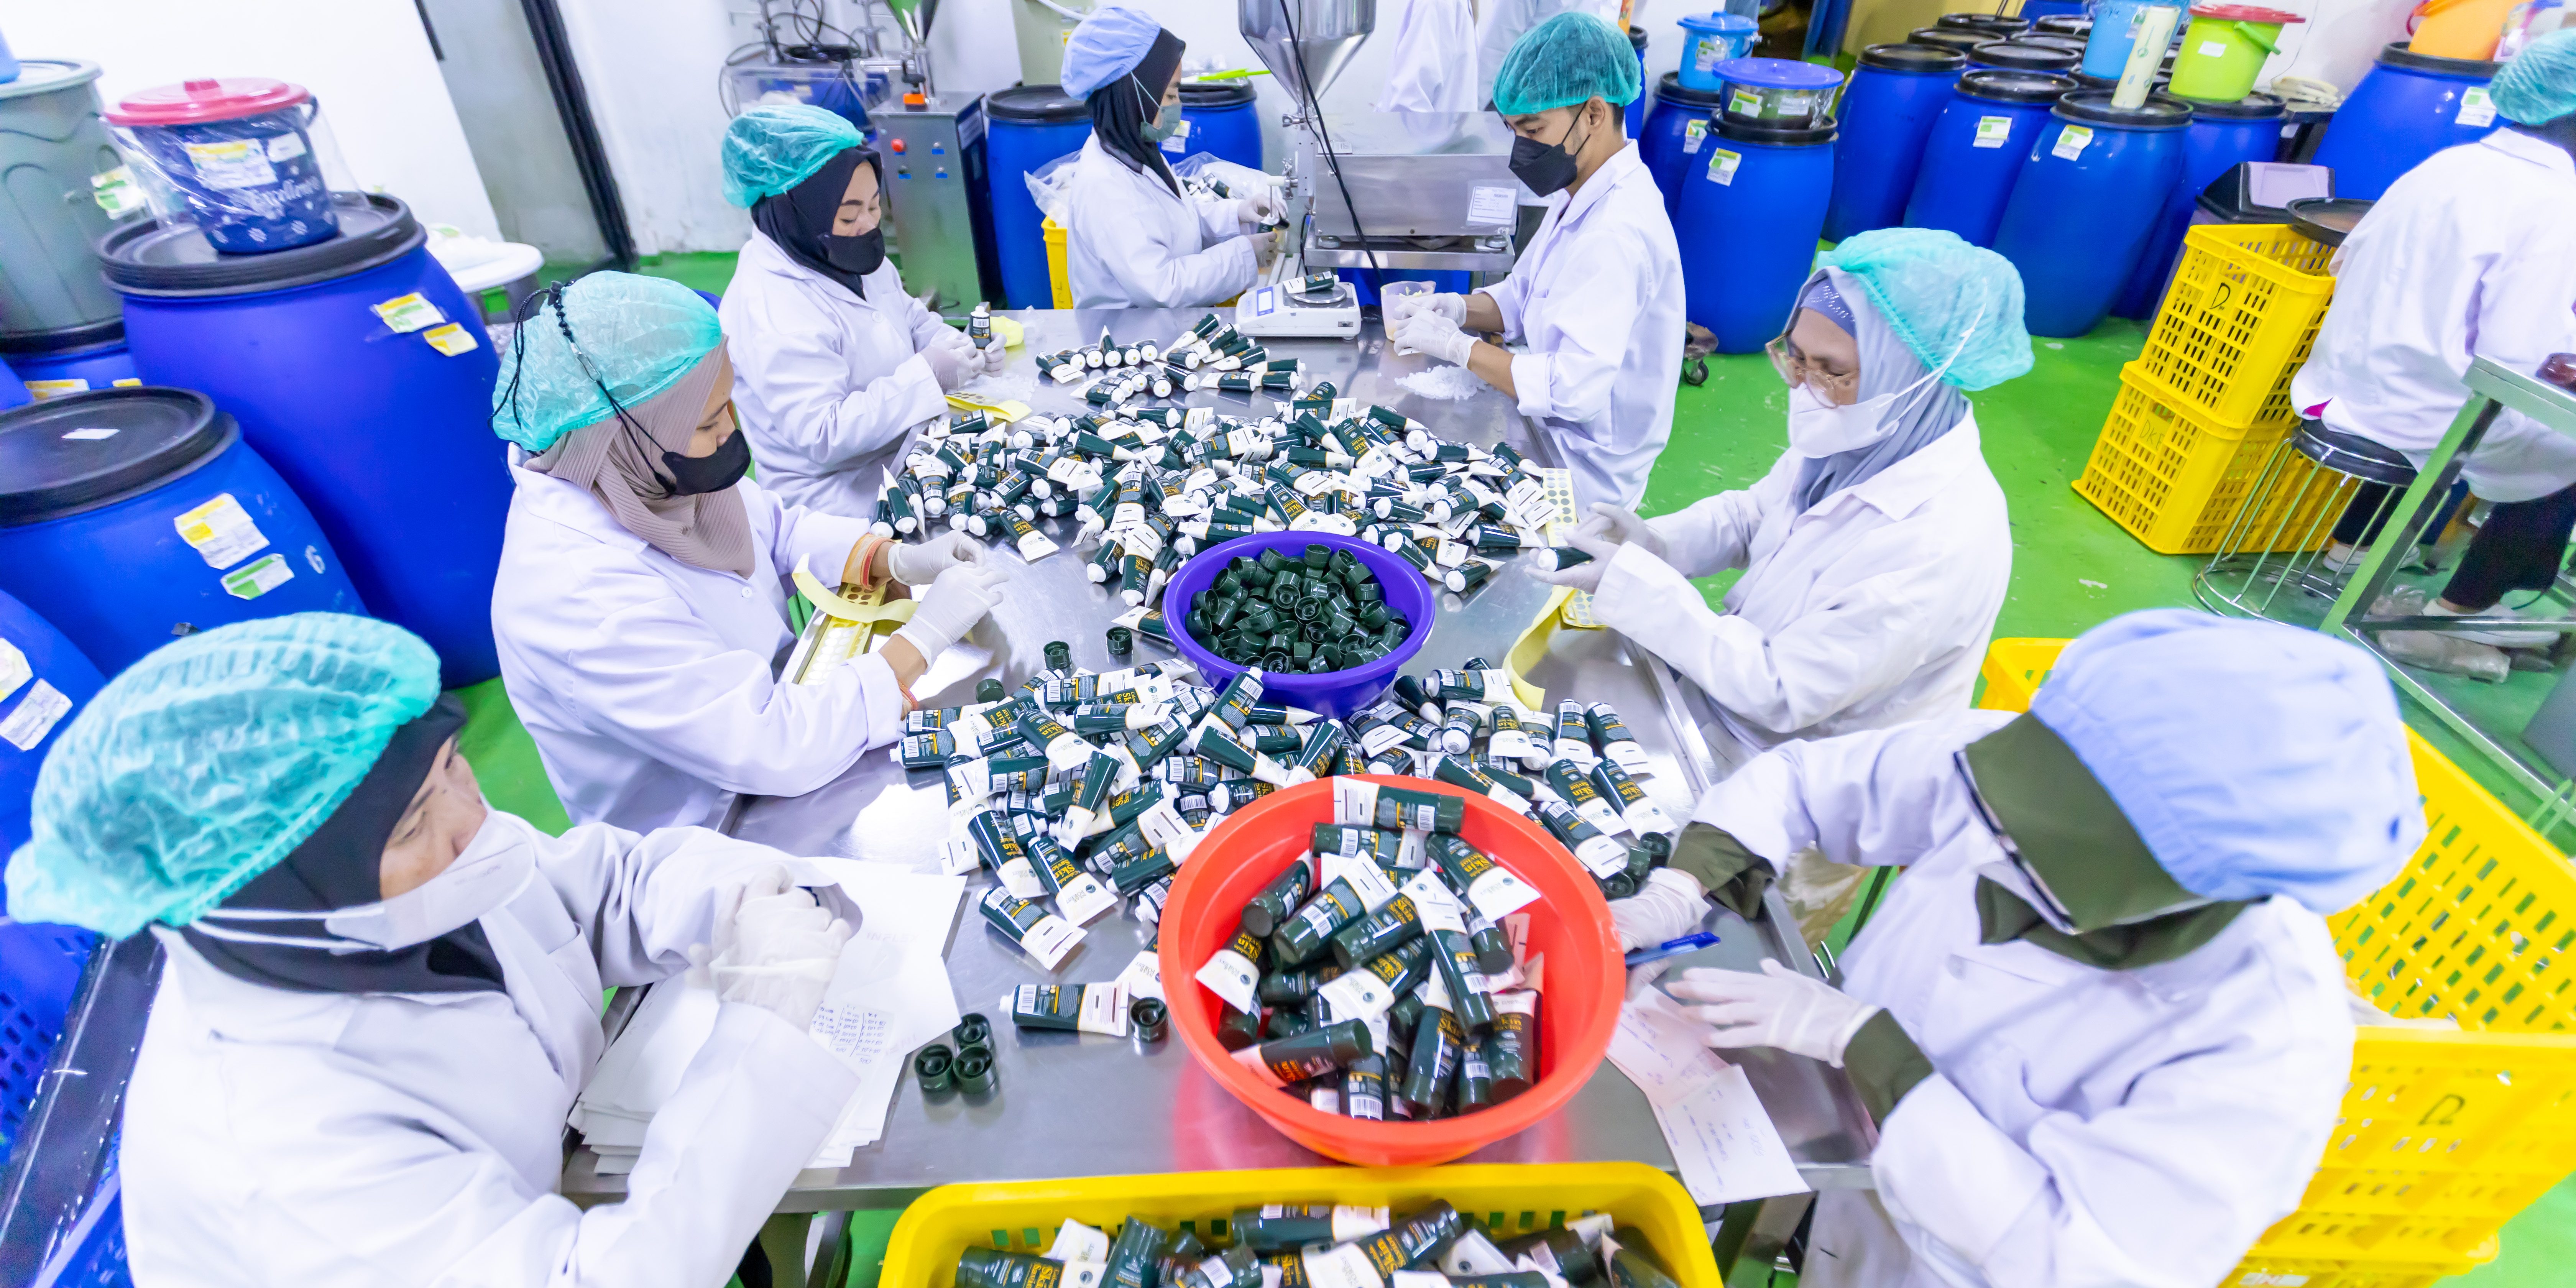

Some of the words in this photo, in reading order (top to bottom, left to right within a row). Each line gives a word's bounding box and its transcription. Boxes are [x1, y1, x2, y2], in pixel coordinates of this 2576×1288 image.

[1286, 503, 1302, 513] Skin
[1123, 693, 1132, 704] Ski
[1041, 725, 1065, 735] Skin
[1572, 787, 1594, 797] Skin
[1620, 787, 1641, 795] Skin
[1055, 864, 1075, 879] Skin
[1464, 859, 1490, 872] Skin
[1396, 899, 1414, 922] Skin
[1237, 937, 1258, 959] Skin
[1135, 961, 1155, 974] FOREST
[1377, 1237, 1398, 1275] Skin
[1036, 1266, 1053, 1288] Ski
